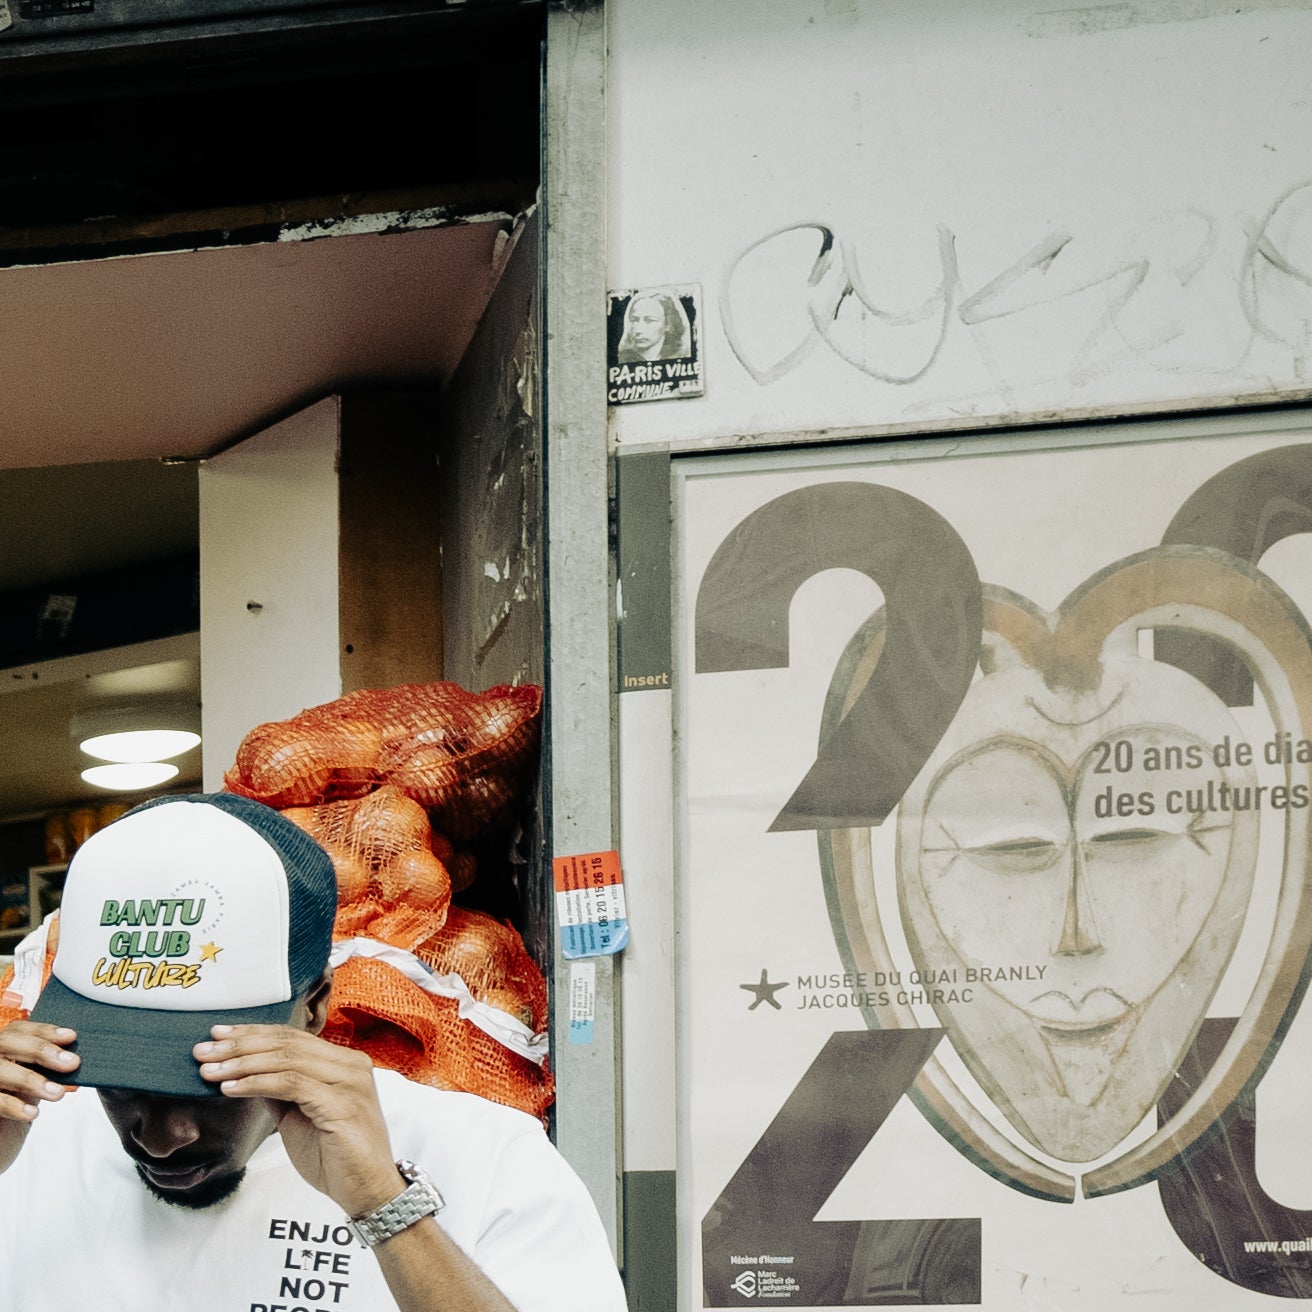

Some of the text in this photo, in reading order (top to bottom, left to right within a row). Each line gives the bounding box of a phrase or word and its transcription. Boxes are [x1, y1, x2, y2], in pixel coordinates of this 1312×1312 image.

[608, 381, 674, 403] COMMUNE
[1093, 740, 1133, 774] 20
[1143, 744, 1203, 771] ans
[1213, 735, 1253, 768] de
[1094, 780, 1309, 818] des cultures
[593, 872, 604, 884] 26
[100, 899, 206, 926] BANTU
[596, 901, 607, 912] 20
[109, 931, 191, 957] CLUB
[92, 957, 202, 990] CULTURE
[875, 971, 902, 987] DU
[909, 969, 957, 985] QUAI
[966, 964, 1048, 982] BRANLY
[797, 988, 974, 1010] JACQUES CHIRAC
[269, 1218, 361, 1249] ENJO
[279, 1276, 349, 1303] NOT
